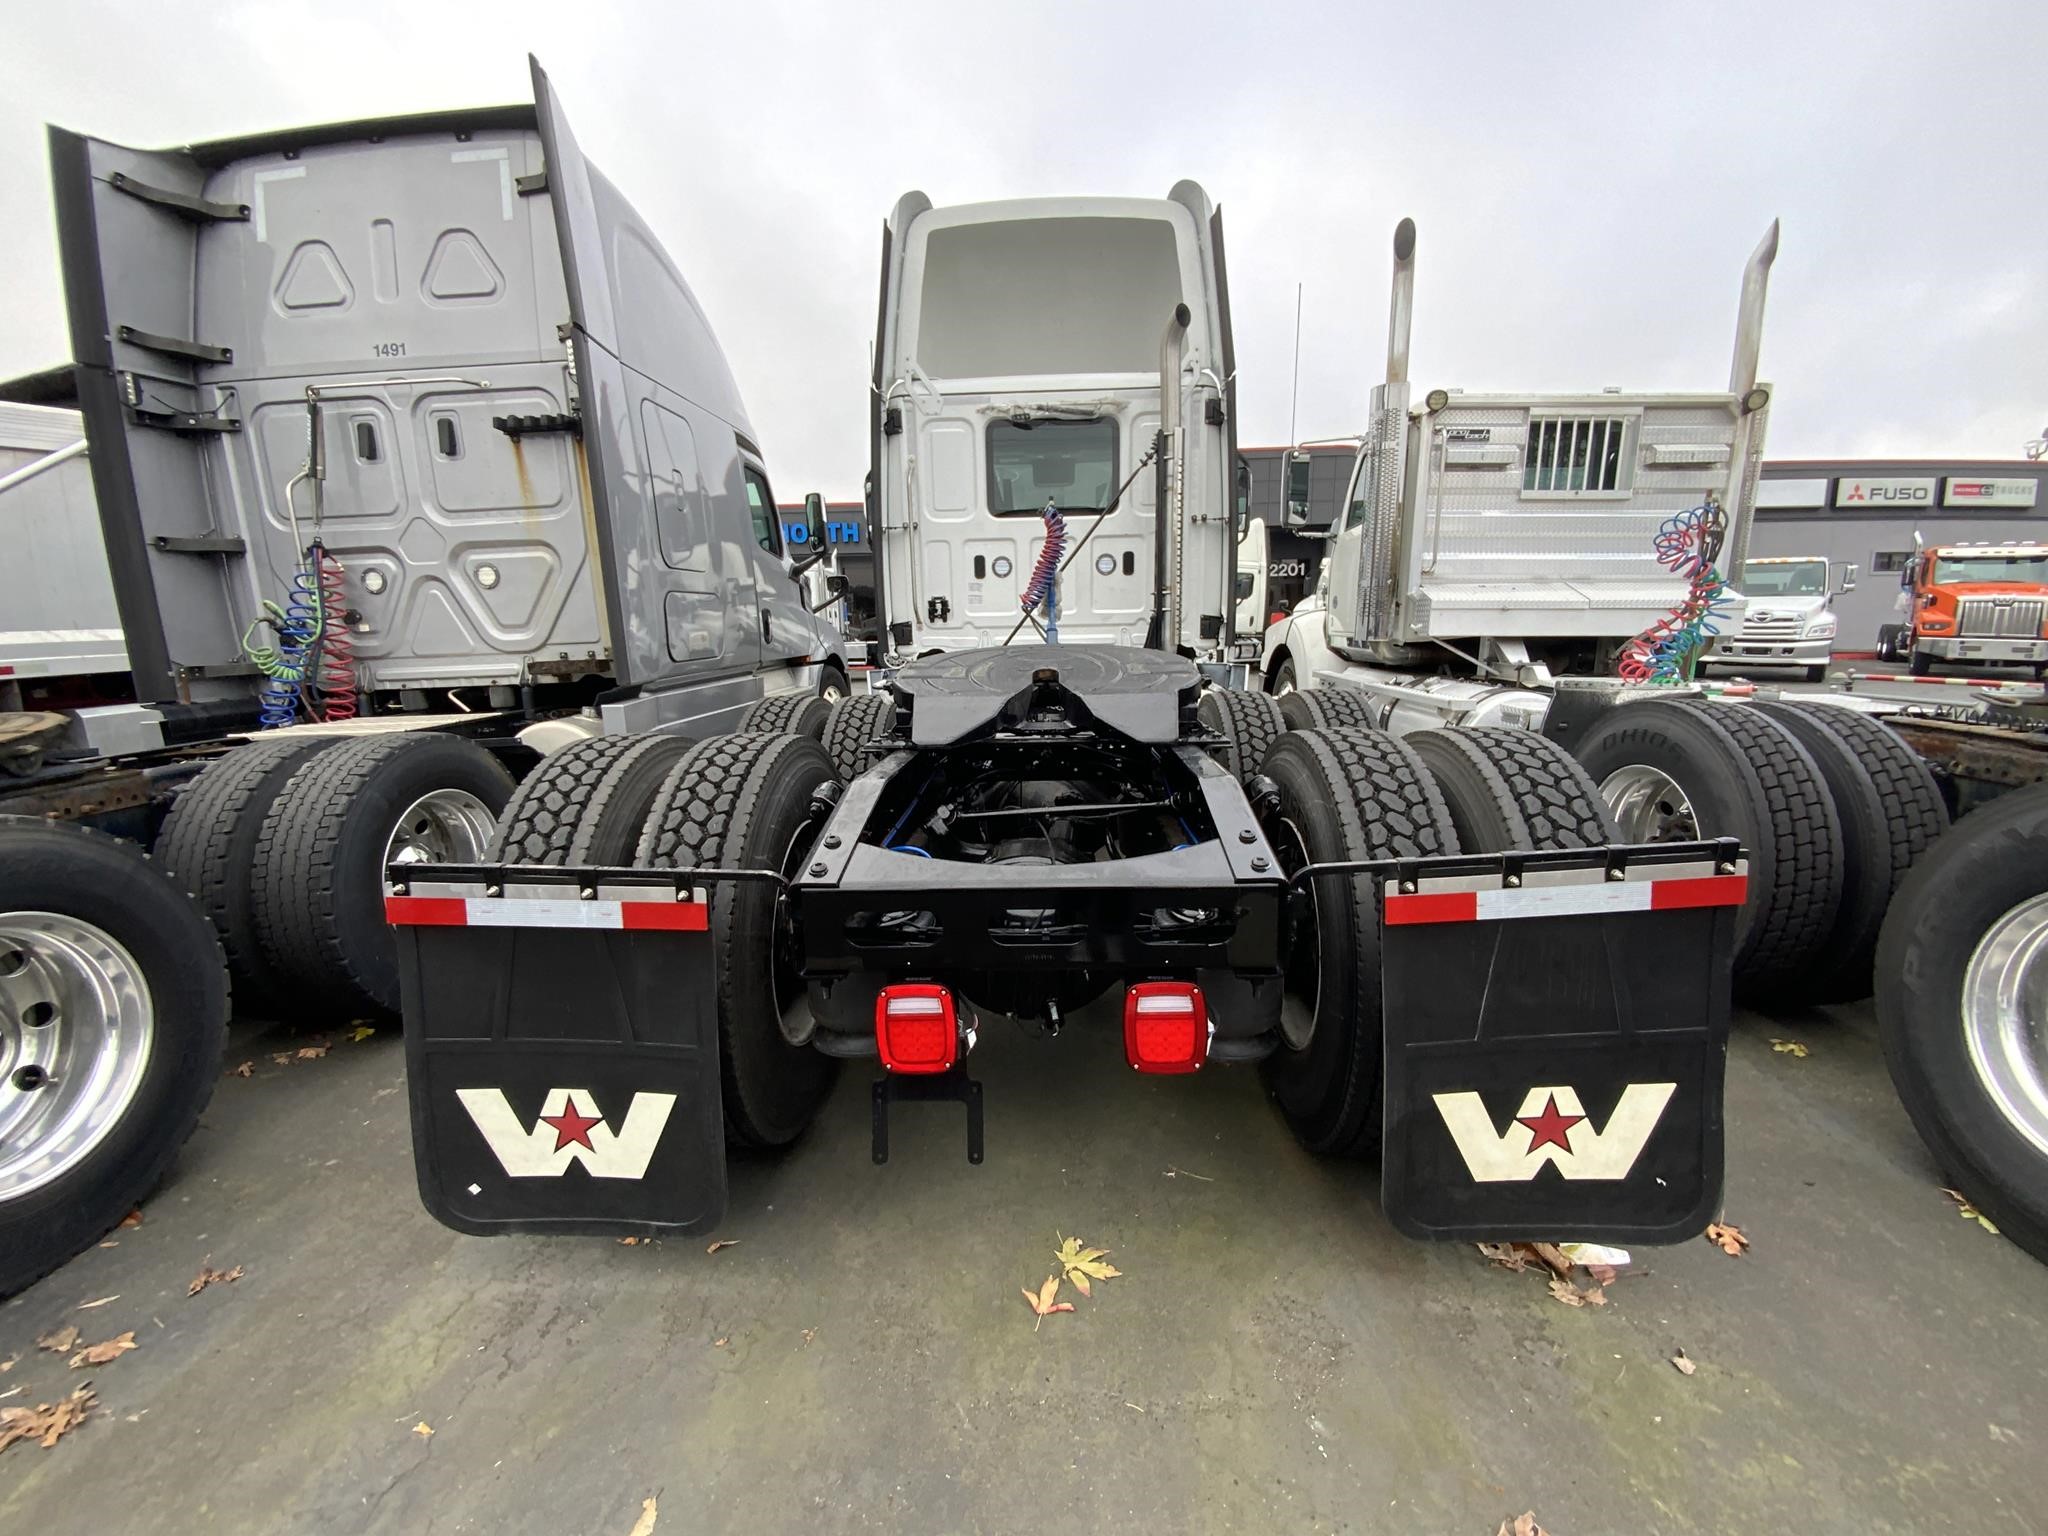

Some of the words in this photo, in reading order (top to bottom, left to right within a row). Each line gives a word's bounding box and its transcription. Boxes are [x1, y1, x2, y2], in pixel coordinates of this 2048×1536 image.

[372, 342, 406, 357] 1491
[1869, 487, 1929, 500] FUSO
[783, 521, 859, 544] OTH
[1269, 562, 1305, 577] 2201
